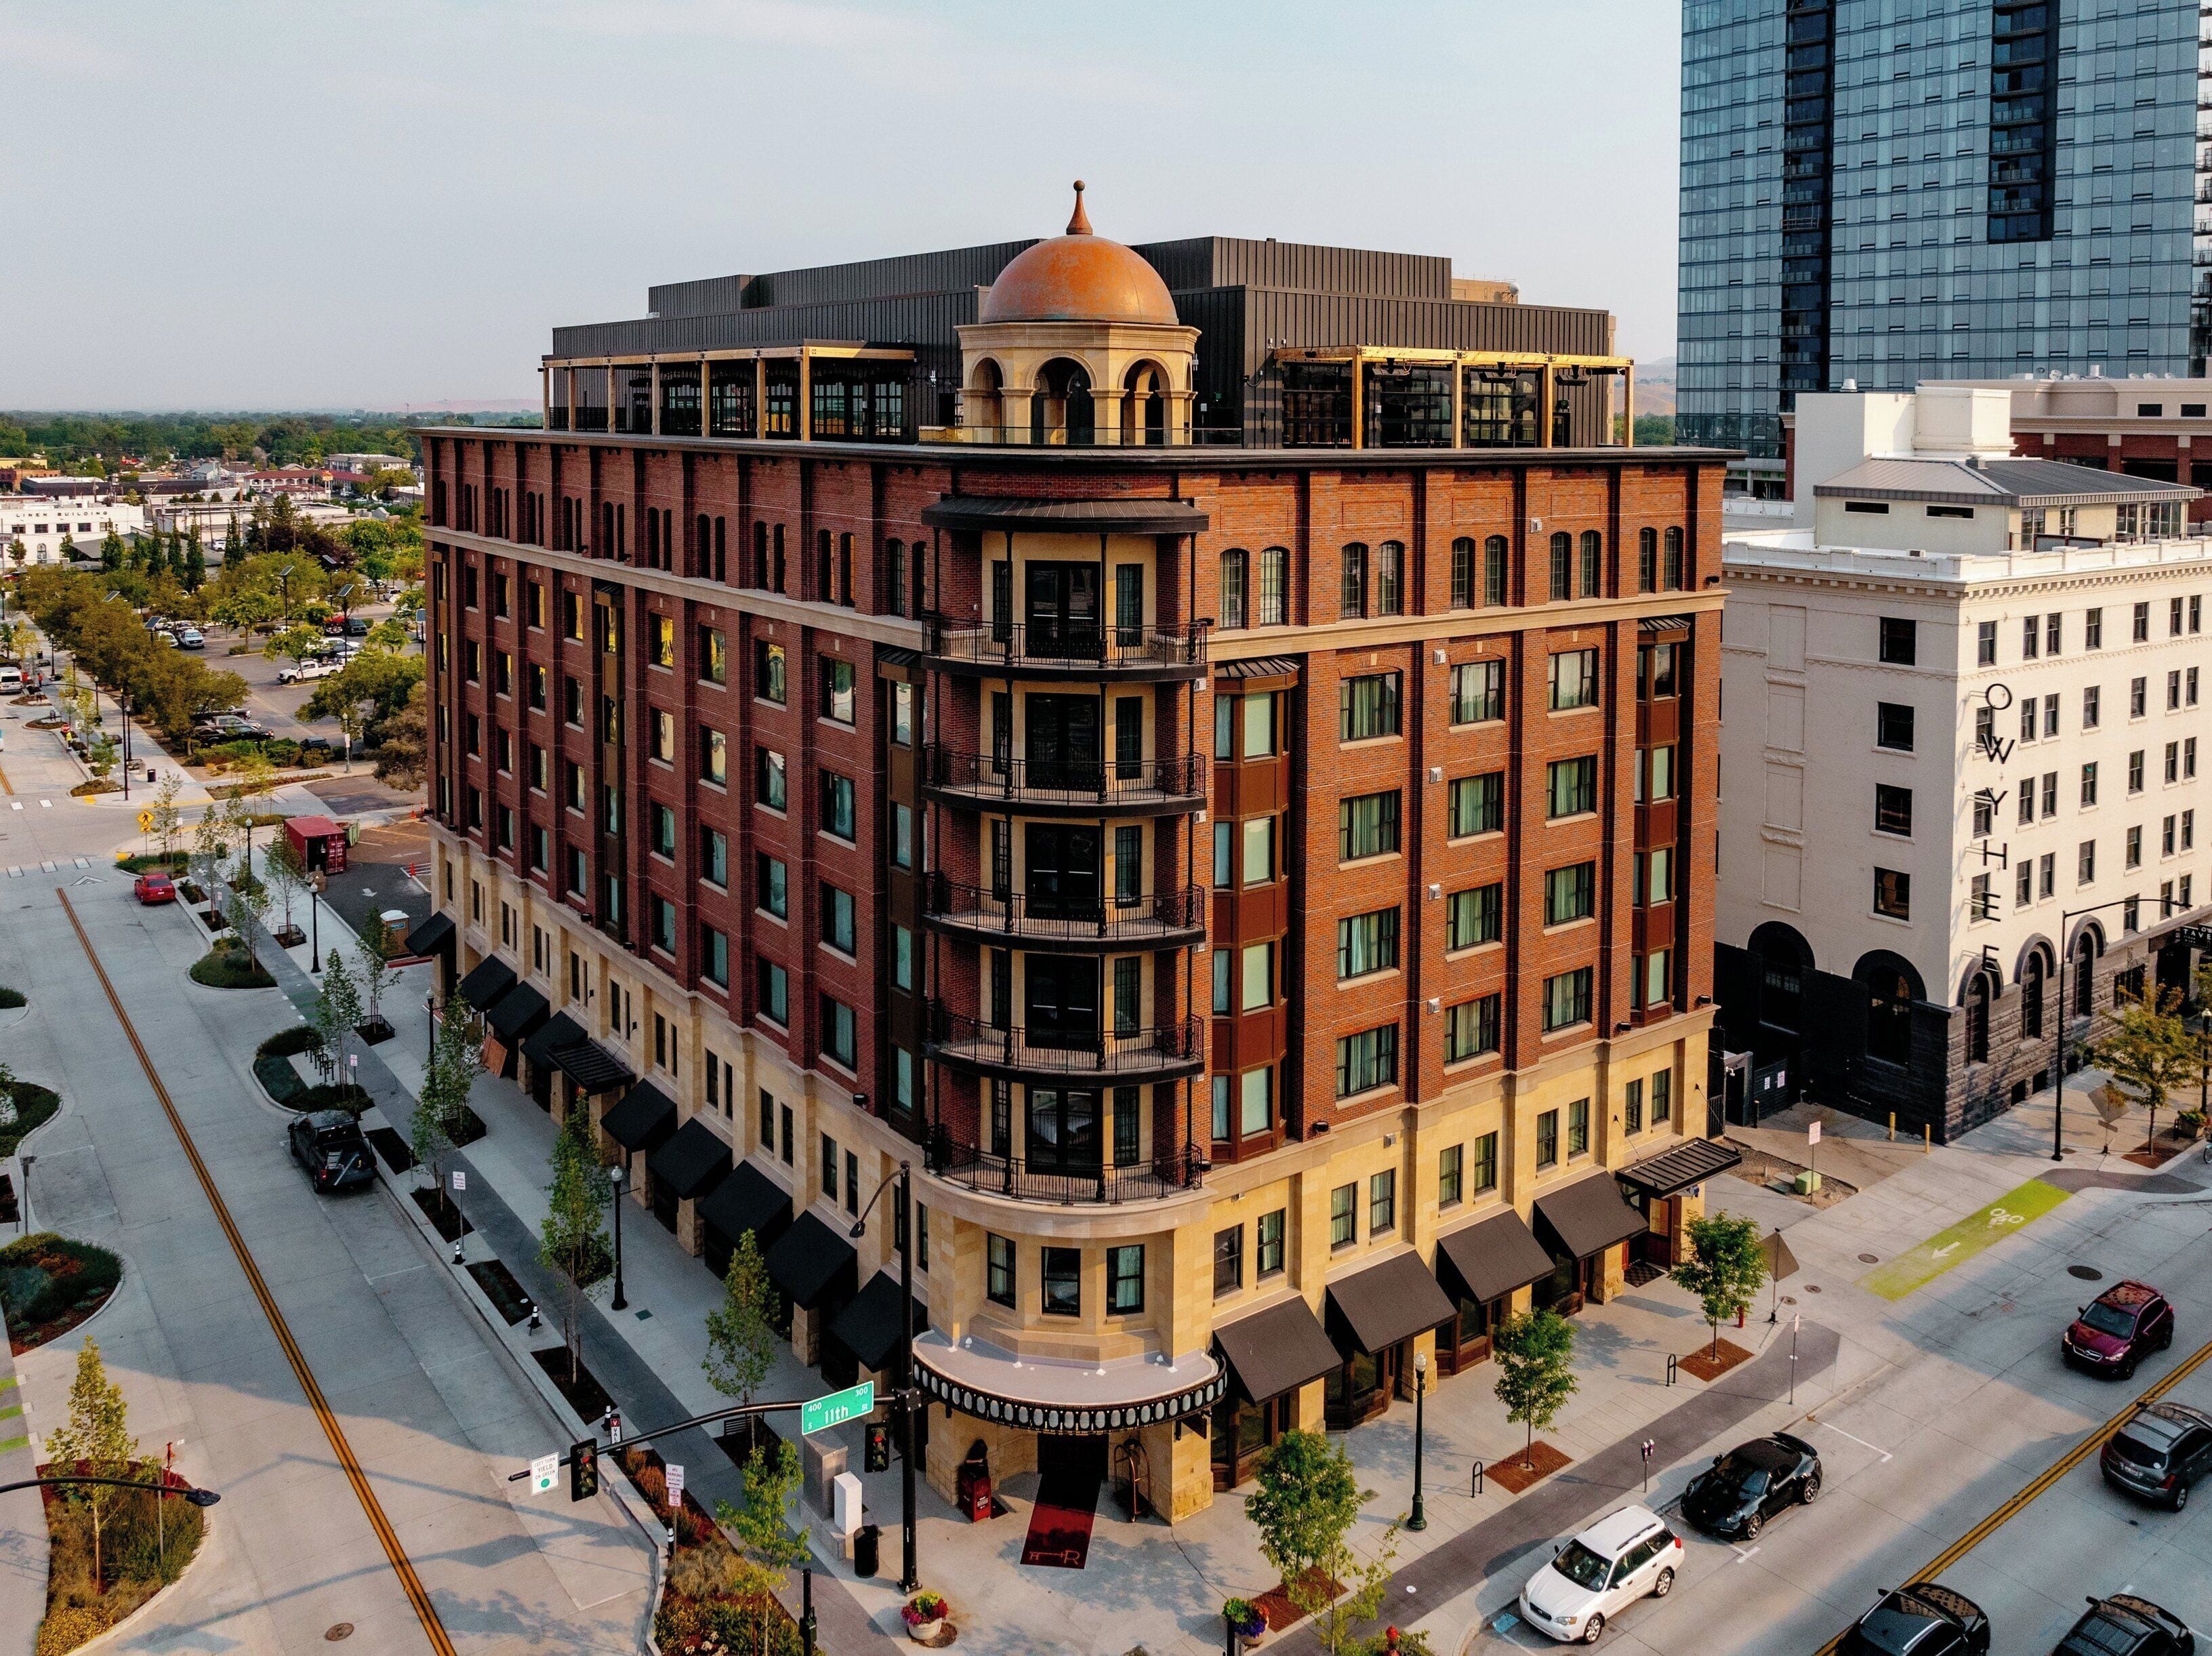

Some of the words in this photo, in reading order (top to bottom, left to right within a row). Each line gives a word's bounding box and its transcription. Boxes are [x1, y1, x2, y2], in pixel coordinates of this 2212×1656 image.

[1981, 683, 2015, 971] OWYHEE
[855, 1386, 868, 1397] 300
[808, 1402, 822, 1413] 400
[825, 1405, 848, 1424] 11th
[861, 1403, 868, 1412] St
[538, 1463, 553, 1472] YIELD
